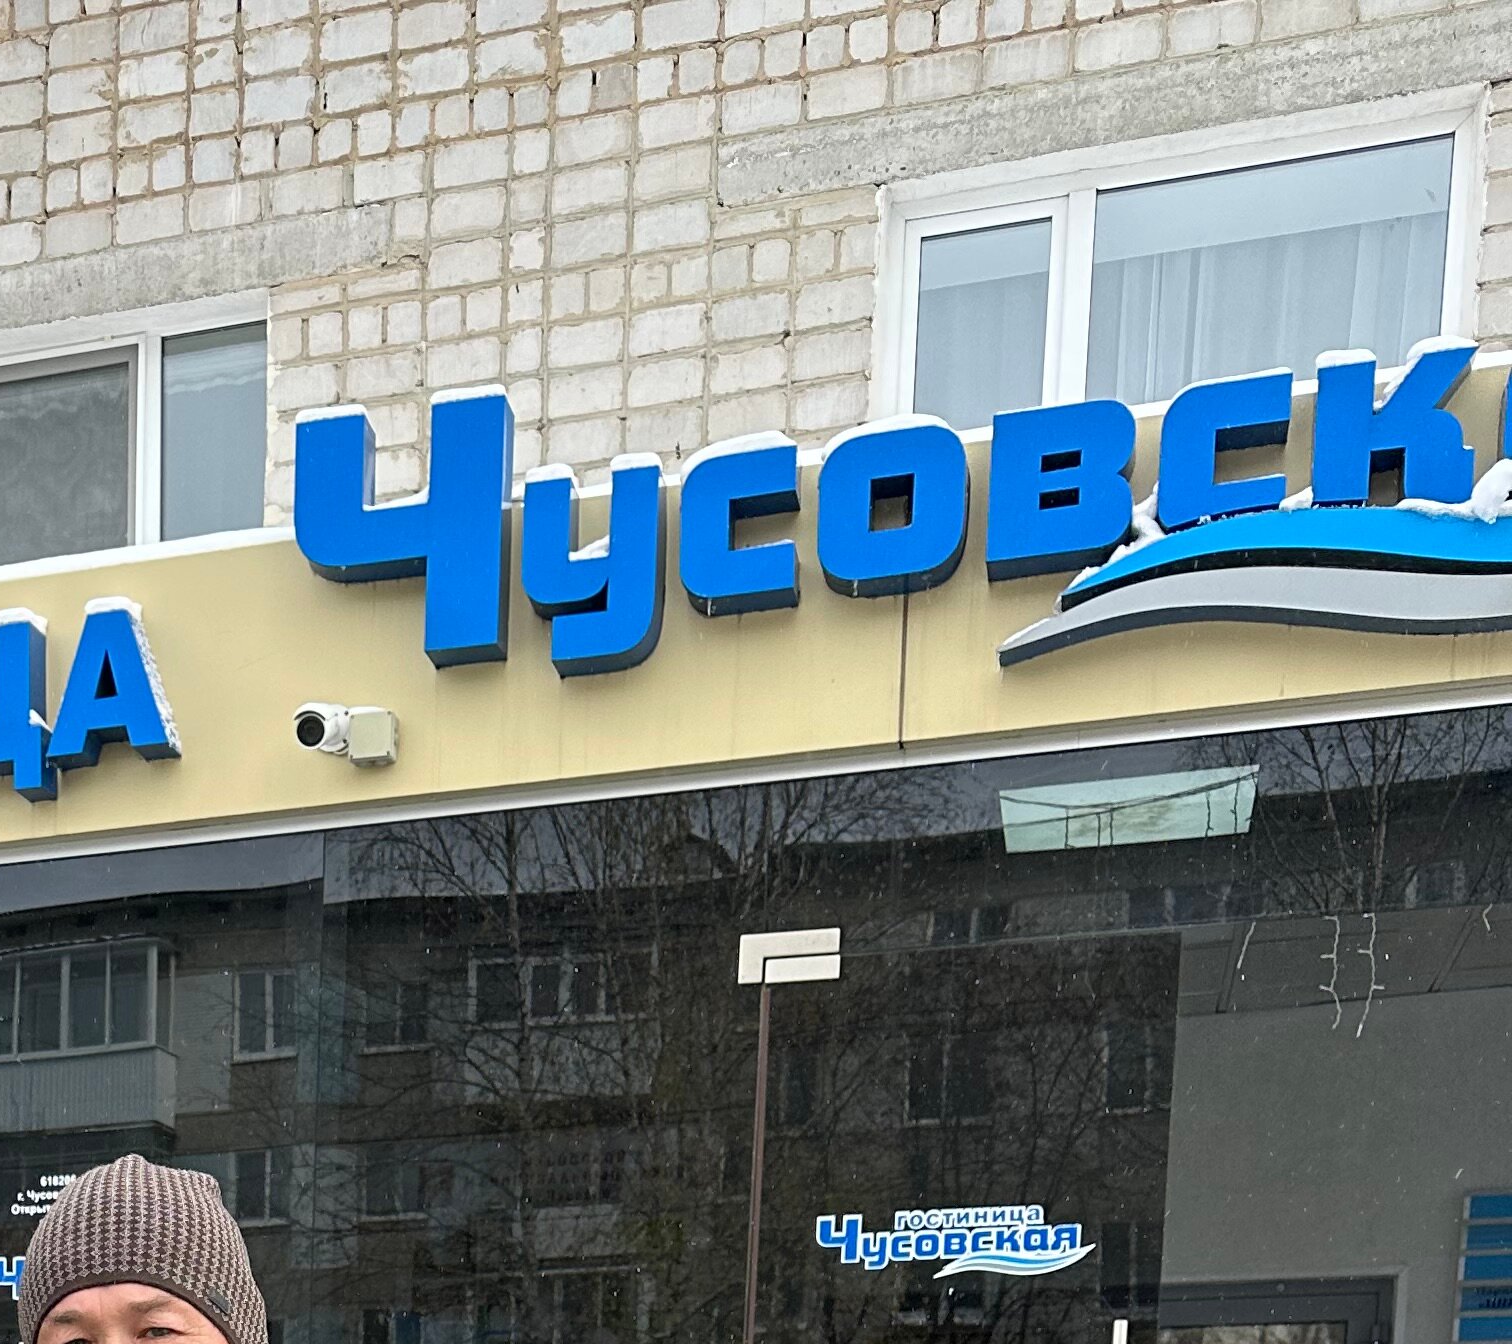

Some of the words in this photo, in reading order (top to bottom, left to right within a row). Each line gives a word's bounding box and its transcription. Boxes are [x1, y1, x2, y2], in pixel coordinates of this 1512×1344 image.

[295, 338, 1512, 678] Чусовск
[816, 1213, 1083, 1271] Чусовская
[894, 1204, 1044, 1230] гостиница
